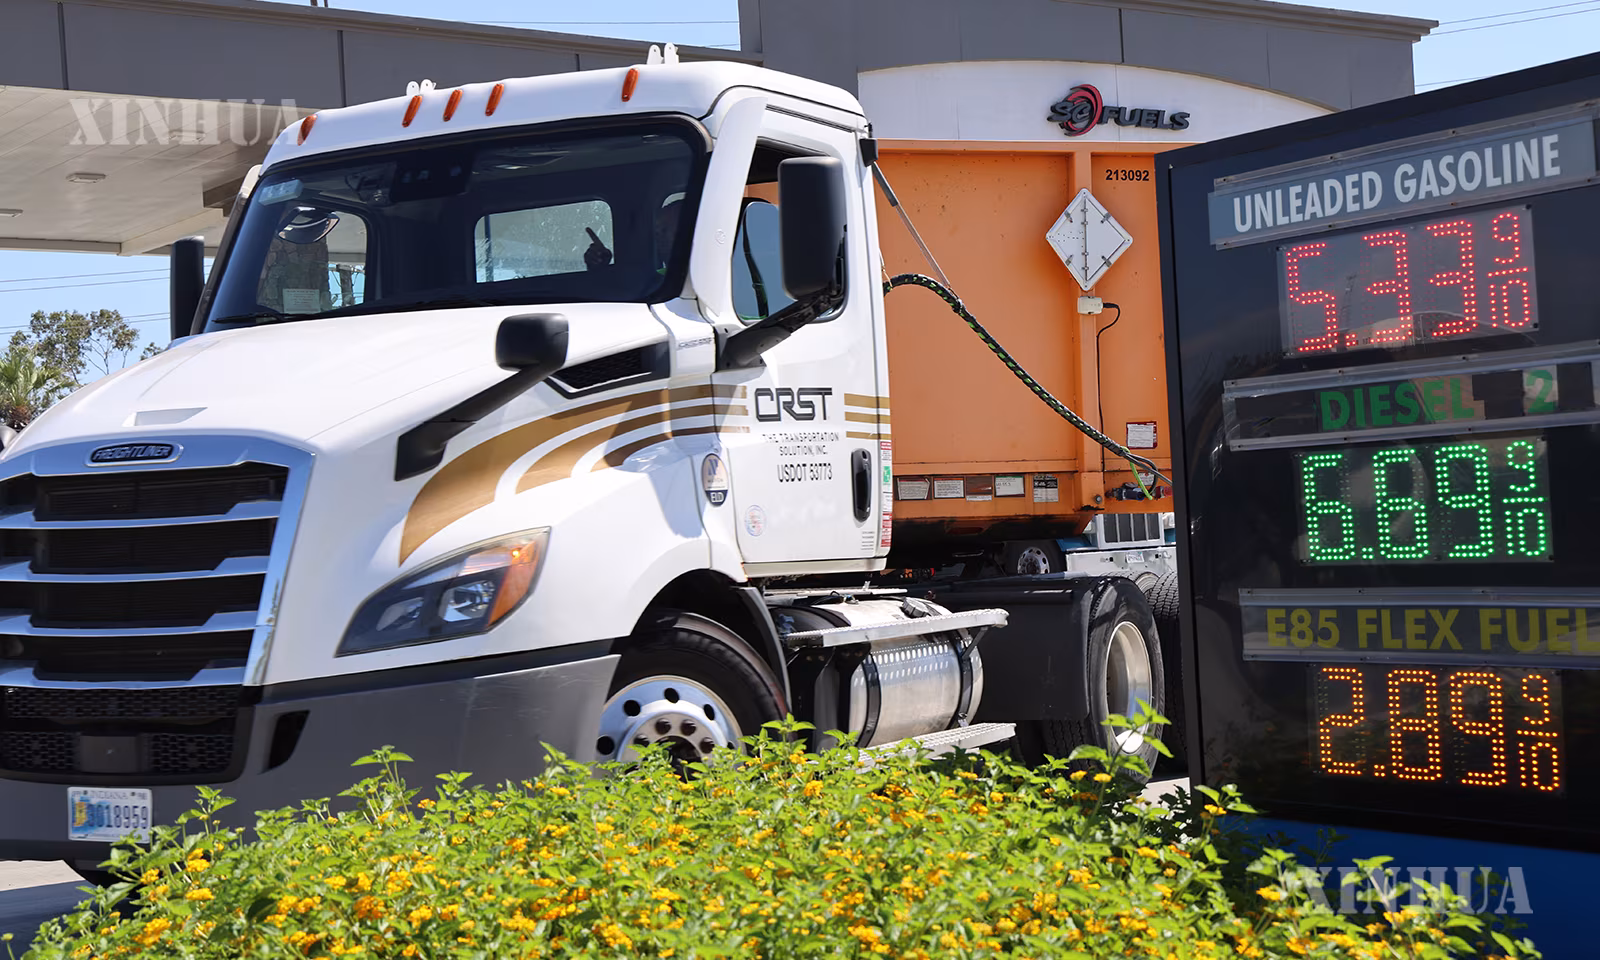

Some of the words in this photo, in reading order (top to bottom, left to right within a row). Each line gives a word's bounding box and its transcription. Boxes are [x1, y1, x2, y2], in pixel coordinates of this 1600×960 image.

[1097, 106, 1191, 131] FUELS
[1105, 169, 1150, 182] 213092
[1233, 170, 1383, 233] UNLEADED
[1394, 133, 1561, 203] GASOLINE
[1286, 219, 1479, 352] 5.33
[754, 387, 833, 422] CRST
[1319, 377, 1475, 431] DIESEL
[1525, 369, 1556, 413] 2
[92, 445, 172, 460] FREIGHTLINER
[779, 432, 840, 443] TRANSPORTATION
[777, 463, 807, 483] USDOT
[809, 463, 833, 481] 53773
[1302, 444, 1494, 561] 6.69
[1266, 608, 1340, 648] E85
[1357, 608, 1463, 650] FLEX
[1479, 607, 1600, 653] FUEL
[1319, 667, 1507, 787] 2.89
